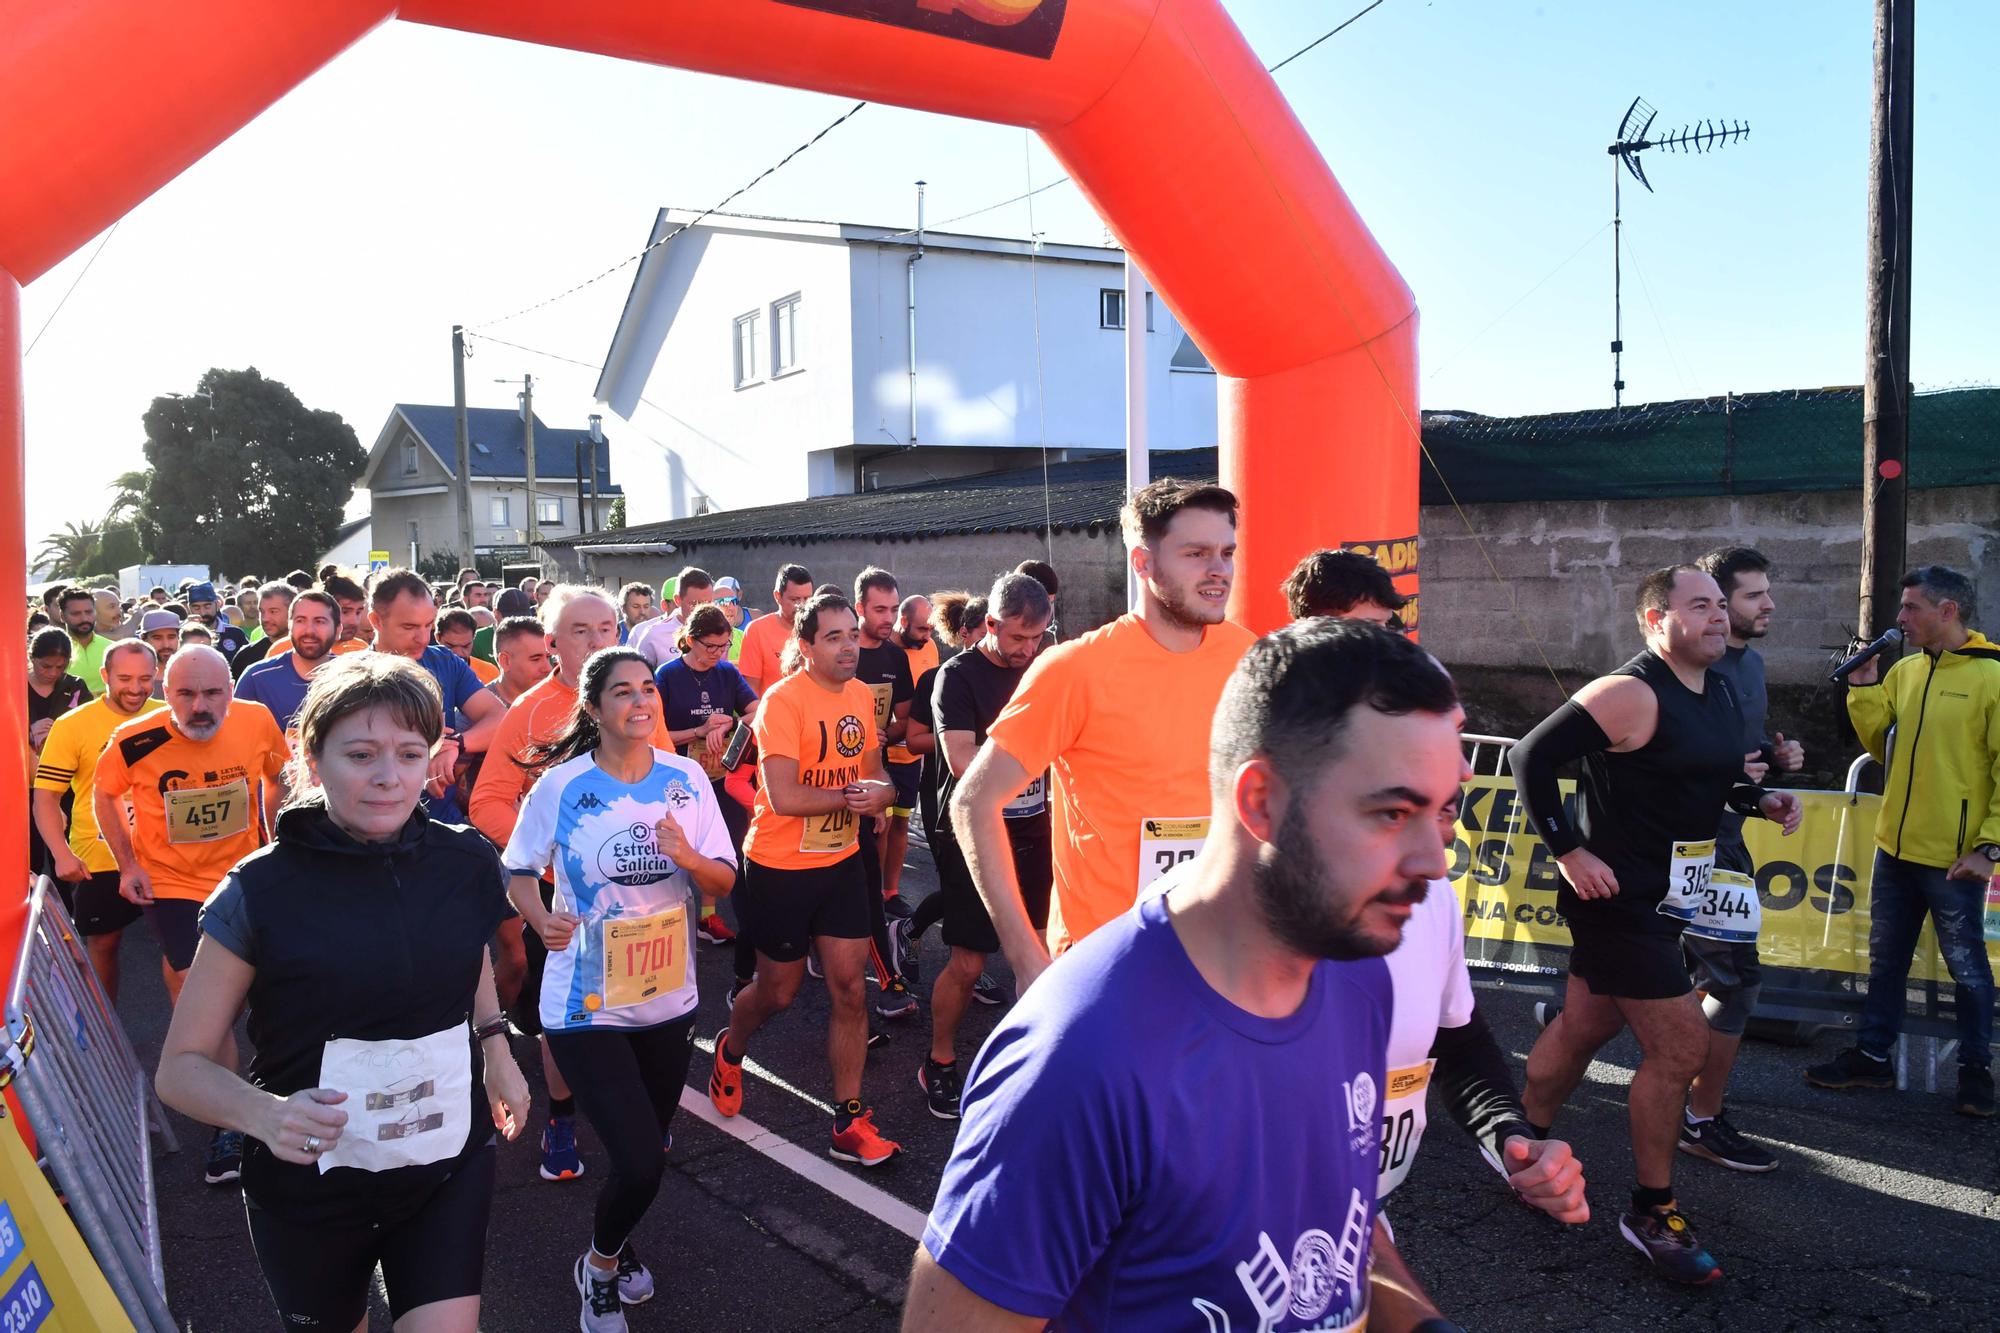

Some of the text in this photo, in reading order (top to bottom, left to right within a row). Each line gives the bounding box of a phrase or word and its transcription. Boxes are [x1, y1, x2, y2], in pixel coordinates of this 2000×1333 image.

[1351, 541, 1418, 572] ADIS
[690, 707, 725, 715] HERCULES
[185, 800, 231, 826] 457
[820, 810, 853, 832] 204
[613, 841, 661, 857] Estrell
[615, 856, 667, 873] Galicia
[1466, 899, 1507, 922] NA
[626, 935, 673, 977] 1701
[4, 1279, 42, 1333] 23.10
